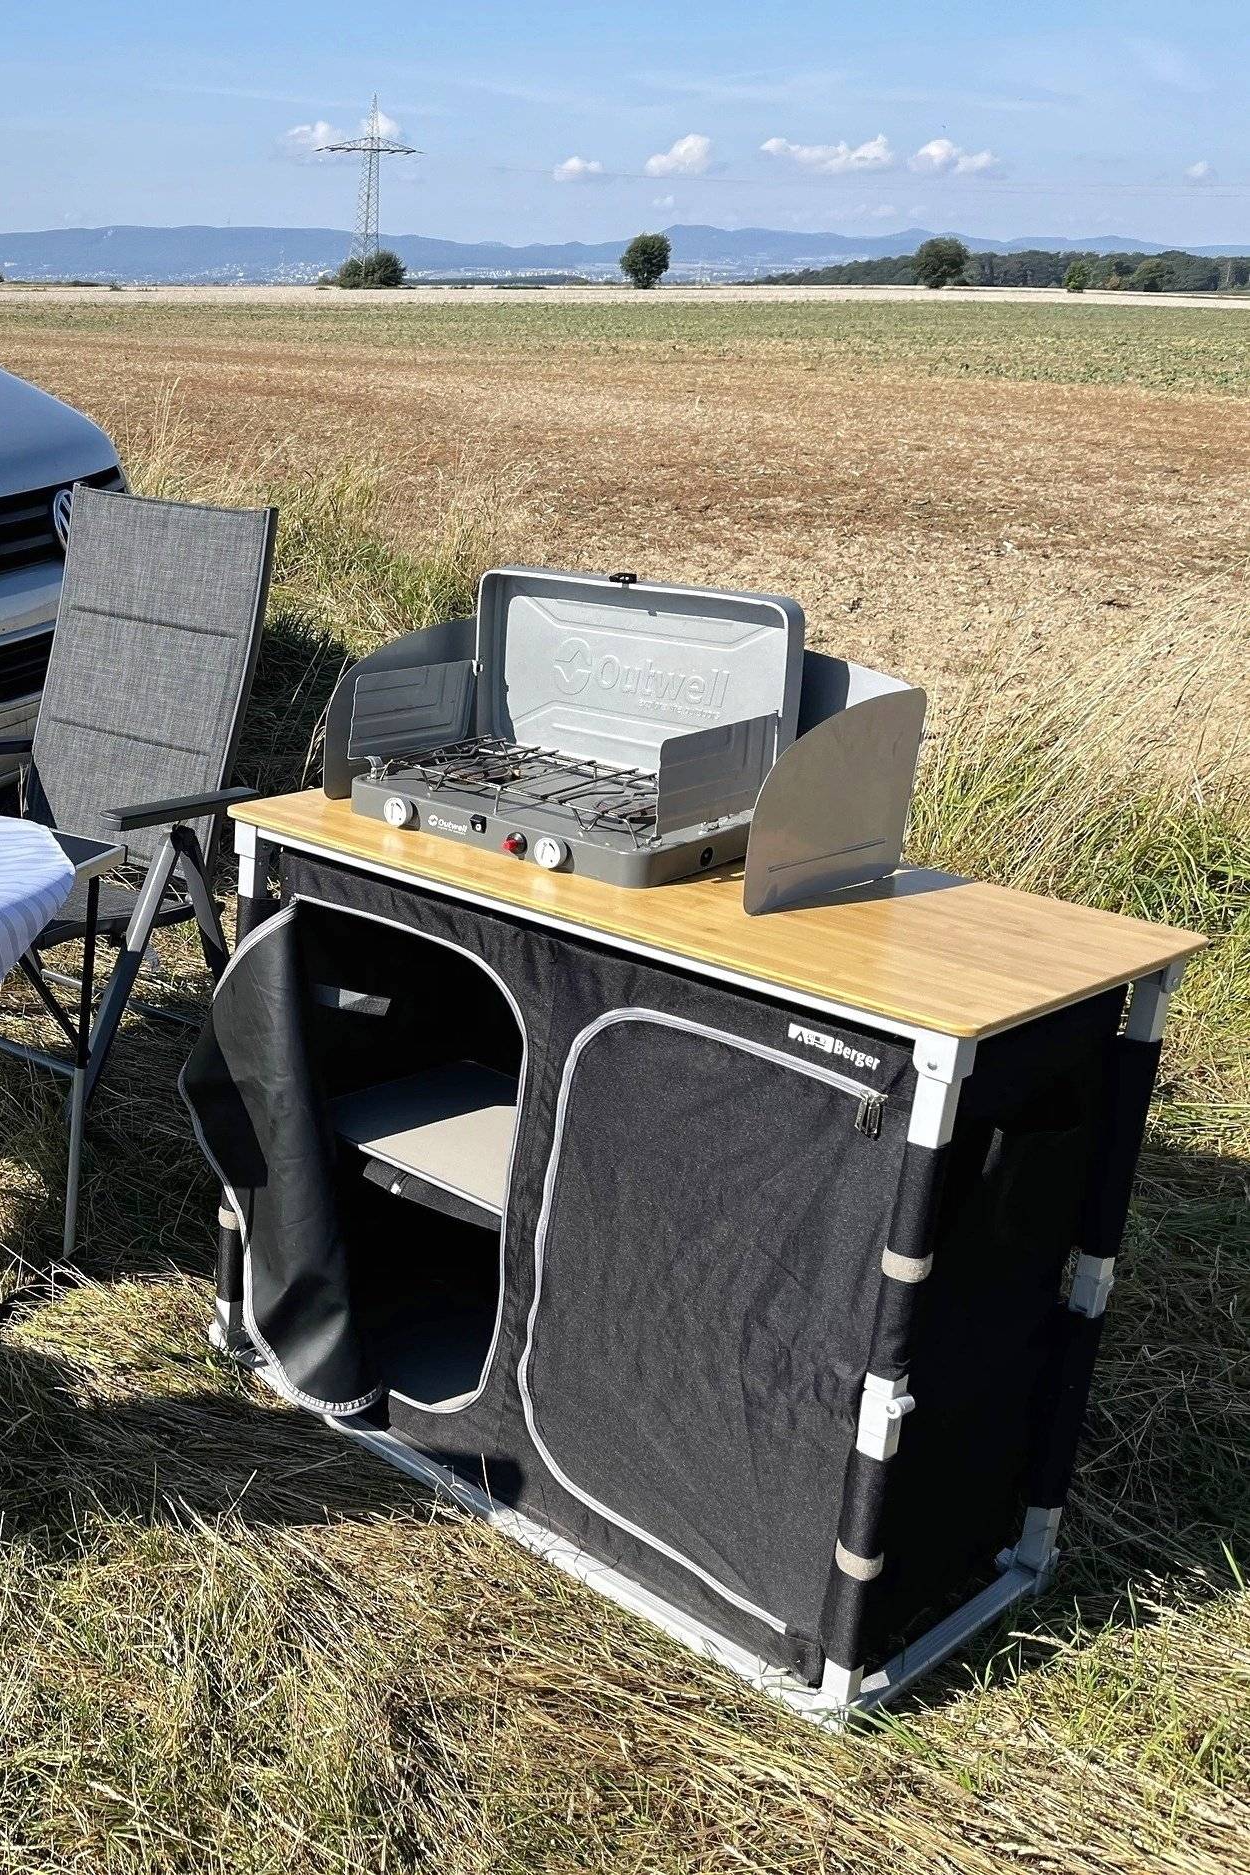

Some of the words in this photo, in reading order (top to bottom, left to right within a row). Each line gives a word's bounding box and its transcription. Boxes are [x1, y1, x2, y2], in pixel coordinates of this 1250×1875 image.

[598, 654, 730, 709] Outwell
[437, 818, 468, 833] Outwell
[833, 1038, 881, 1071] Berger
